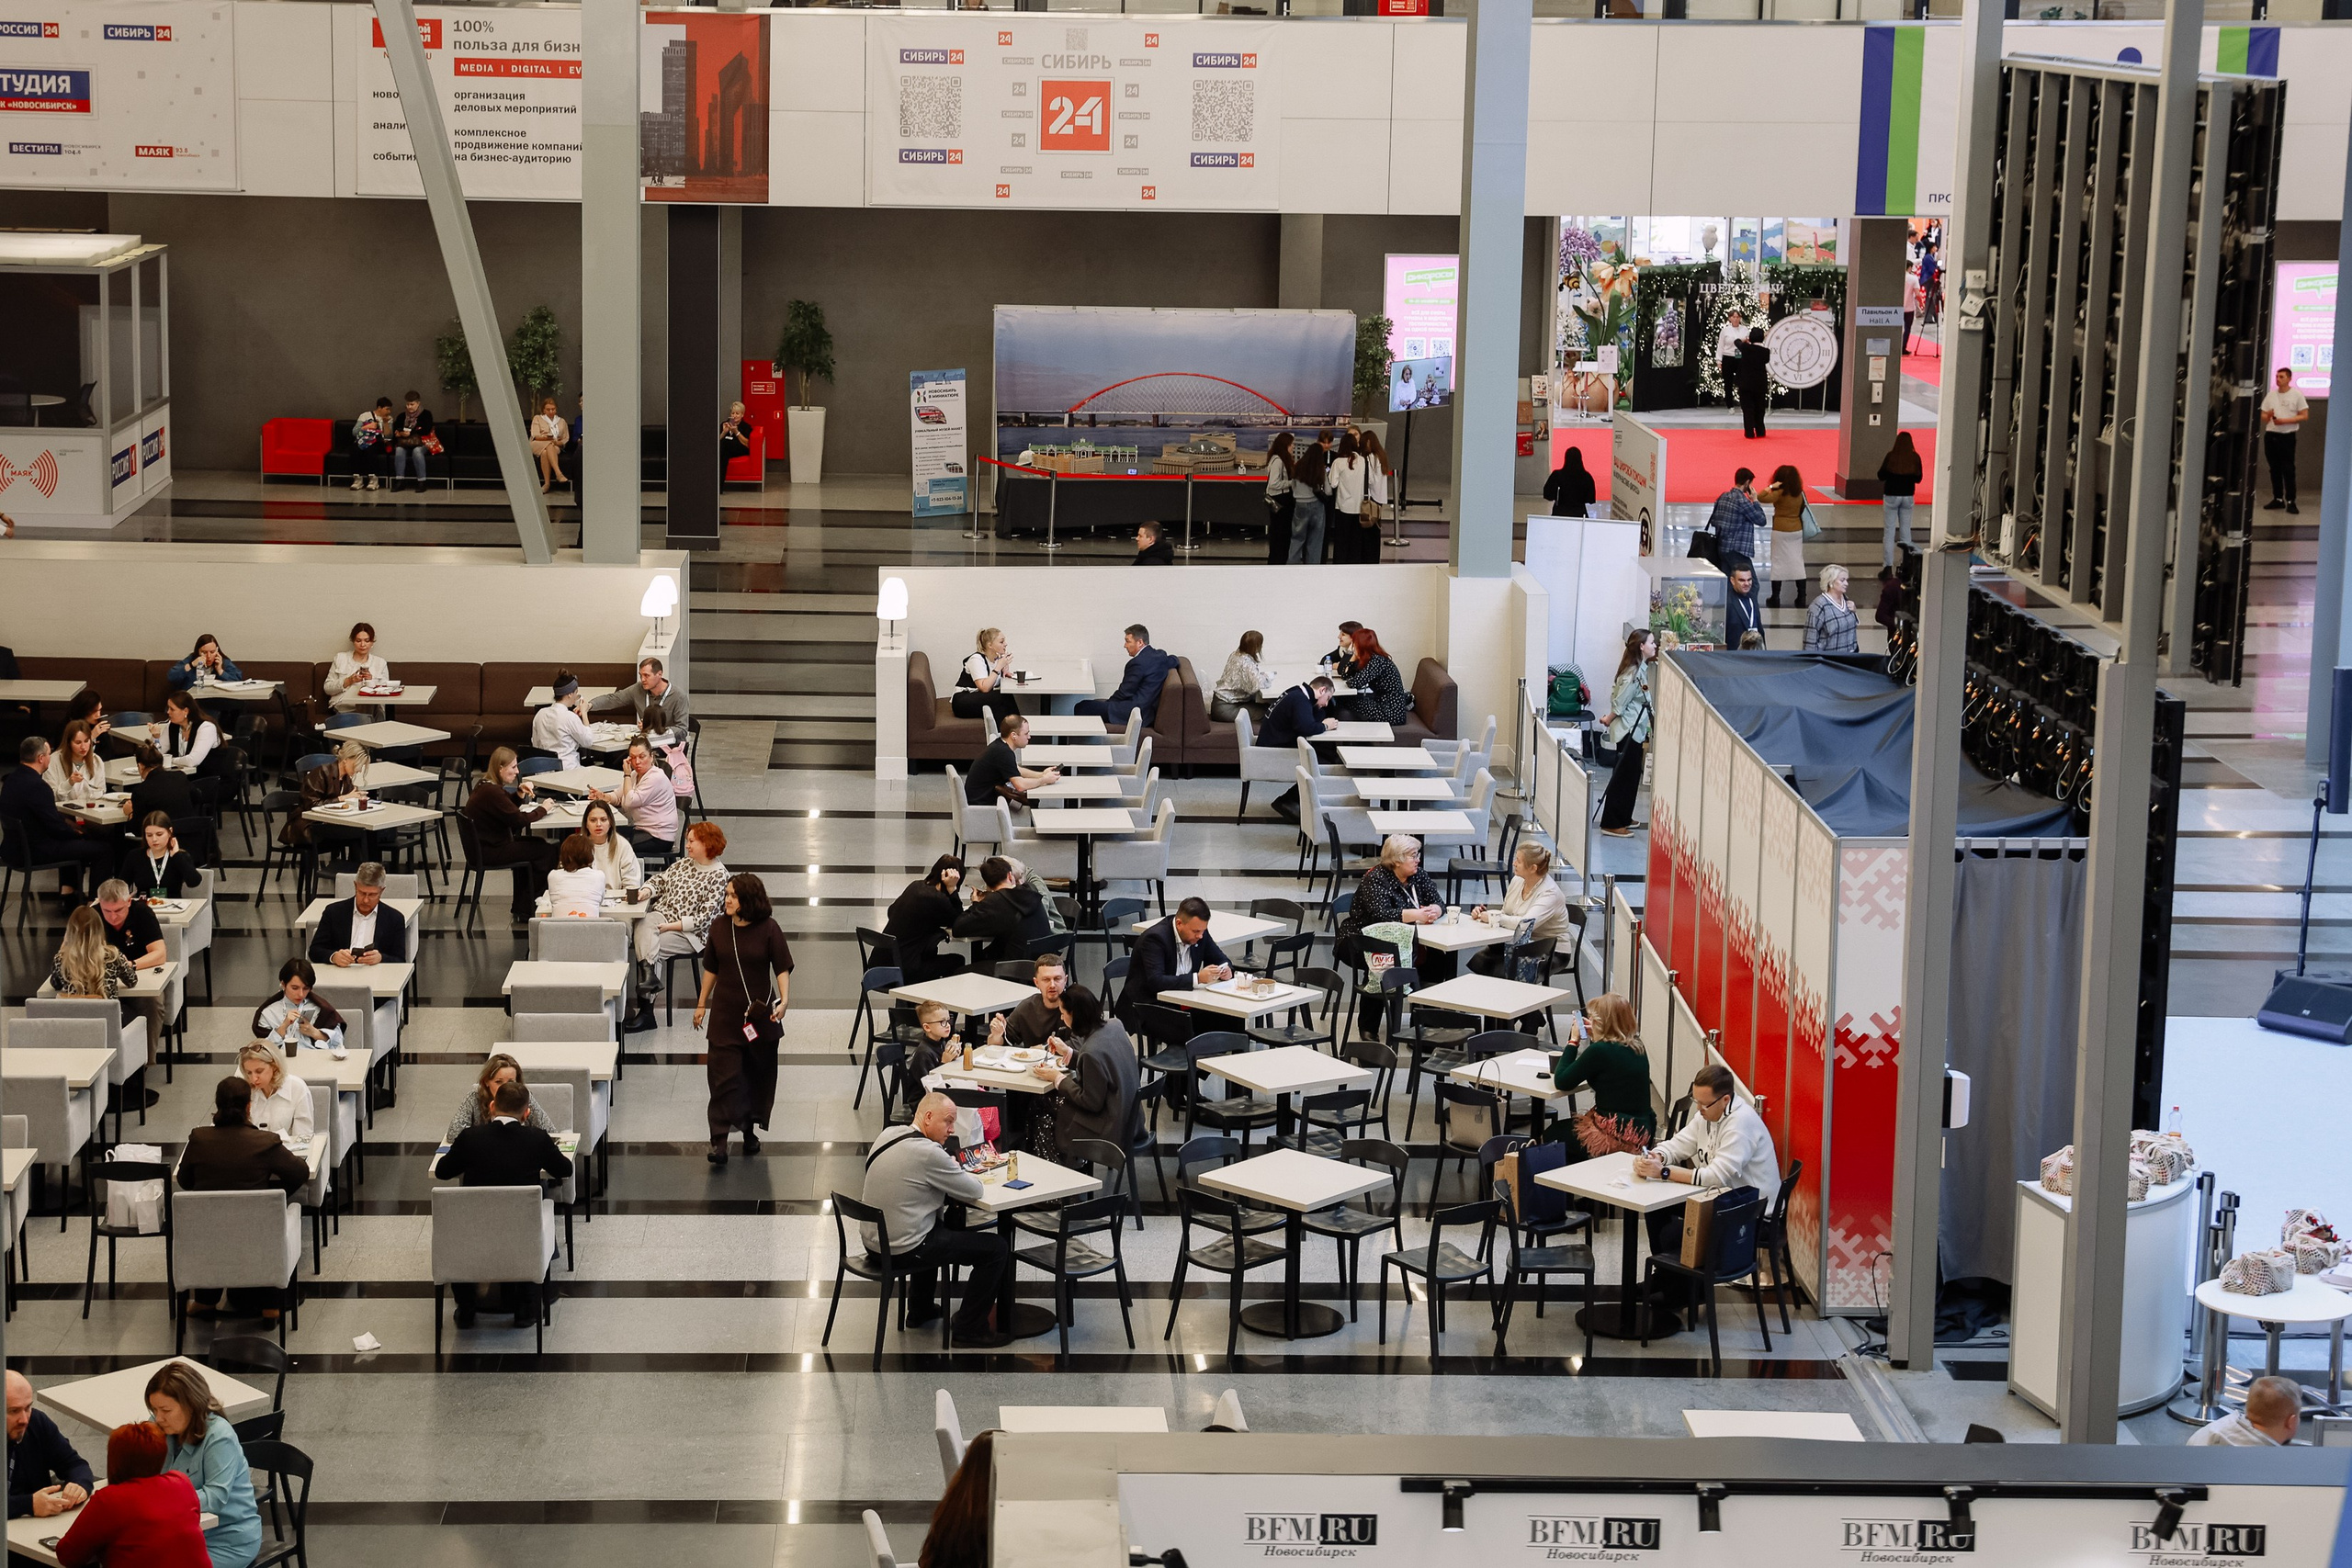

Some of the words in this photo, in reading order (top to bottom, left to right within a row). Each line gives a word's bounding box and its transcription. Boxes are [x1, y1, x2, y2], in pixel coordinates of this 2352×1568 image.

[45, 26, 58, 36] 24
[453, 20, 494, 33] 100%
[107, 27, 152, 38] СИБИРЬ
[158, 29, 171, 39] 24
[999, 34, 1011, 43] 24
[1146, 35, 1158, 45] 24
[453, 40, 508, 51] польза
[512, 42, 539, 53] для
[544, 40, 582, 52] бизн
[903, 51, 945, 62] СИБИРЬ
[950, 53, 962, 62] 24
[1041, 54, 1112, 69] СИБИРЬ
[1196, 55, 1238, 65] СИБИРЬ
[1244, 56, 1255, 65] 24
[460, 63, 494, 73] MEDIA
[511, 65, 551, 73] DIGITAL
[569, 66, 582, 74] EV
[0, 73, 71, 96] ТУДИЯ
[1013, 85, 1025, 93] 24
[373, 90, 400, 99] ново
[1126, 86, 1138, 95] 24
[454, 92, 526, 101] организация
[8, 101, 77, 110] «НОВОСИБИРСК»
[454, 104, 502, 113] деловых
[504, 105, 577, 115] мероприятий
[1049, 96, 1102, 135] 24
[373, 121, 407, 130] анали
[454, 129, 527, 138] комплексное
[454, 141, 529, 151] продвижение
[1125, 137, 1137, 146] 24
[138, 147, 170, 156] МАЯК
[902, 151, 944, 161] СИБИРЬ
[949, 152, 961, 161] 24
[470, 152, 572, 164] бизнес-аудиторию
[1193, 155, 1236, 165] СИБИРЬ
[1241, 156, 1253, 165] 24
[997, 186, 1009, 196] 24
[1142, 188, 1155, 197] 24
[1700, 280, 1785, 294] ЦВЕТОЧЫЙ
[143, 435, 158, 461] РОССИЯ
[112, 455, 129, 481] РОССИЯ
[131, 452, 136, 474] 1
[1245, 1517, 1375, 1542] BFM.RU
[1528, 1519, 1658, 1546] BFM.RU
[1264, 1545, 1357, 1558] Новосибирск
[1546, 1548, 1640, 1562] Новосибирск
[1860, 1551, 1955, 1565] Новосибирск
[2148, 1555, 2245, 1568] Новосибирск
